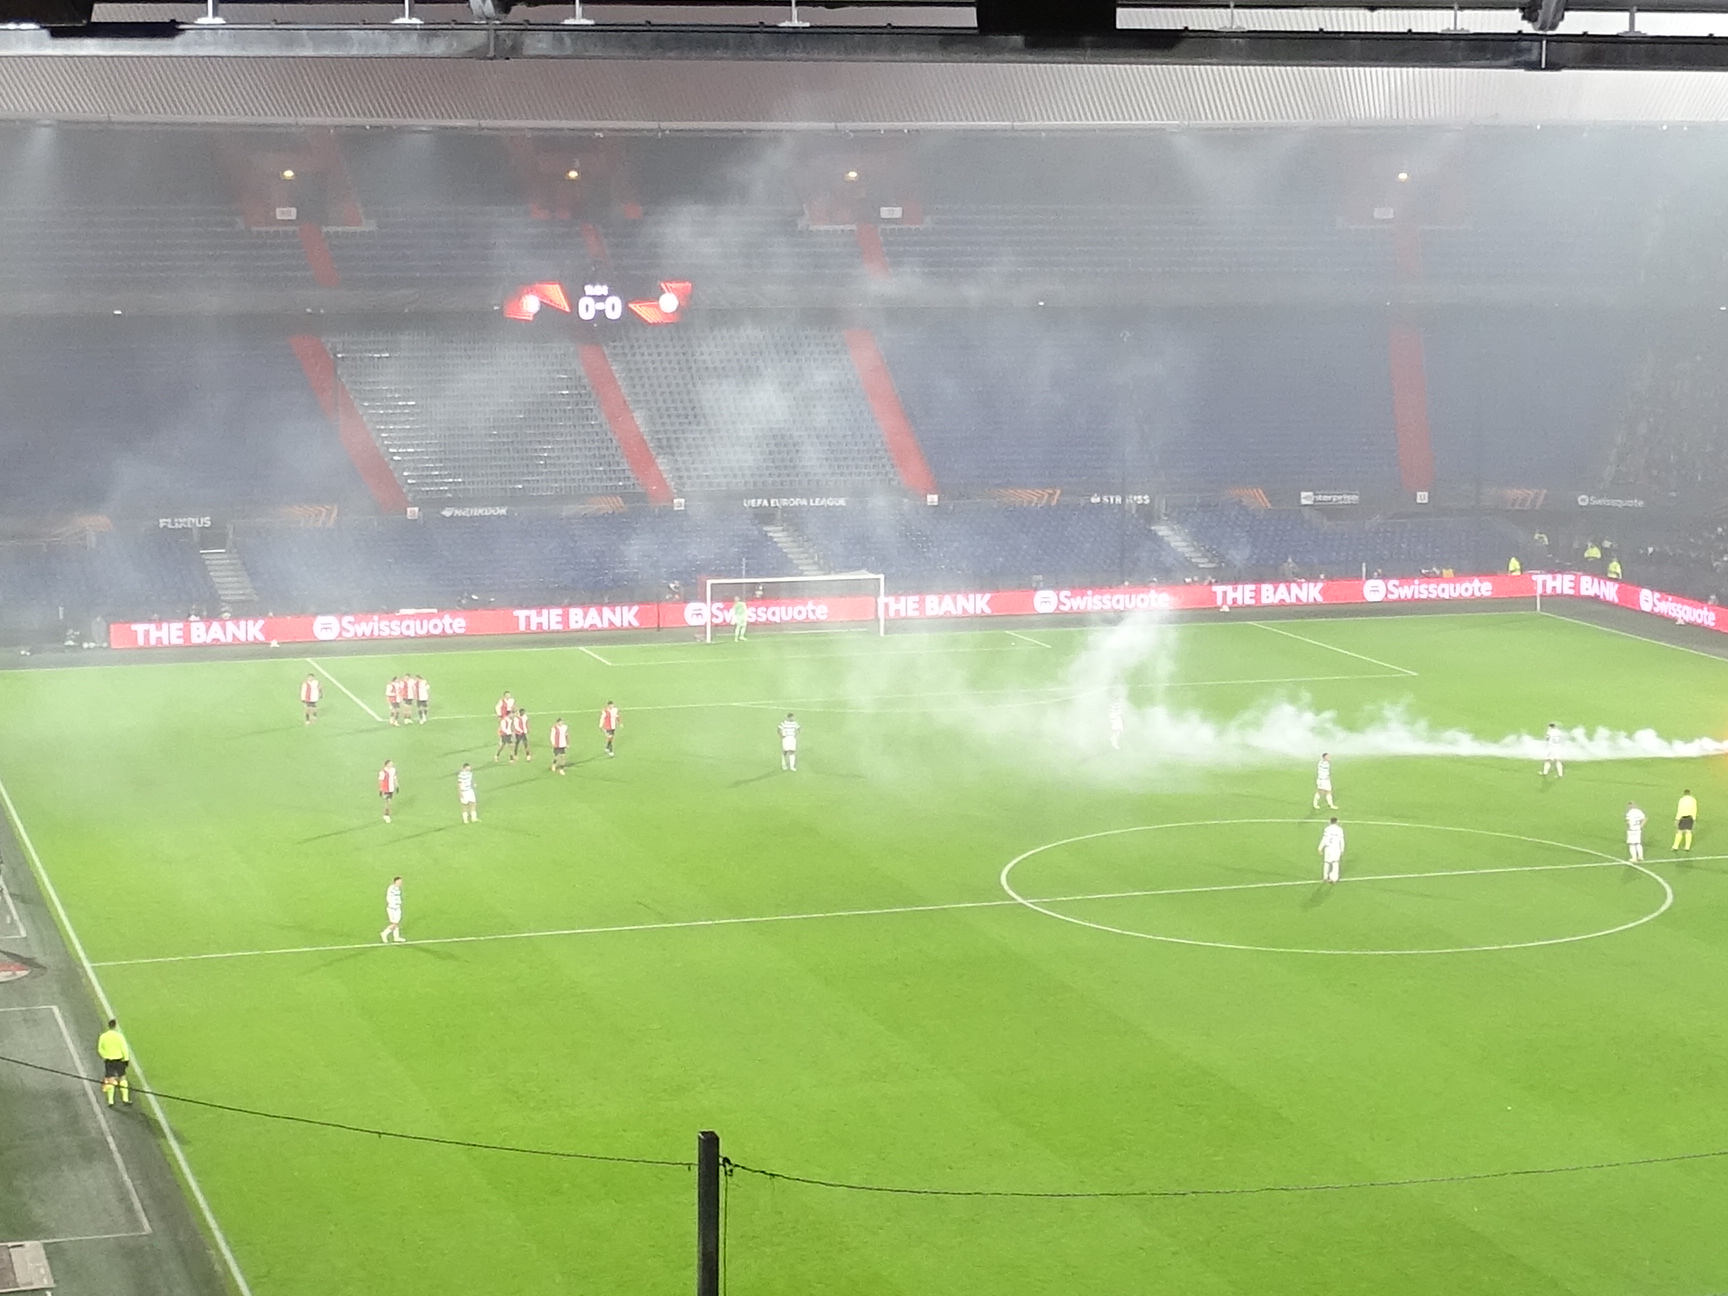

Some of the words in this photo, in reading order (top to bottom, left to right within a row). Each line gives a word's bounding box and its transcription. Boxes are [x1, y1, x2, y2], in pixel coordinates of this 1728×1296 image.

[743, 498, 769, 508] UEFA
[770, 498, 808, 508] EUROPA
[809, 497, 847, 507] LEAGUE
[1589, 495, 1645, 509] Swissquote
[1058, 586, 1170, 613] Swissquote
[1212, 583, 1256, 606] THE
[1258, 581, 1324, 604] BANK
[1387, 576, 1493, 602] Swissquote
[1533, 574, 1576, 596] THE
[1578, 574, 1620, 603] BANK
[710, 599, 830, 625] Swssquote
[924, 592, 993, 616] BANK
[1651, 592, 1717, 629] Swissquote
[341, 612, 467, 640] Swissquote
[513, 608, 560, 632] THE
[563, 605, 641, 630] BANK
[131, 620, 186, 648] THE
[189, 618, 265, 645] BANK
